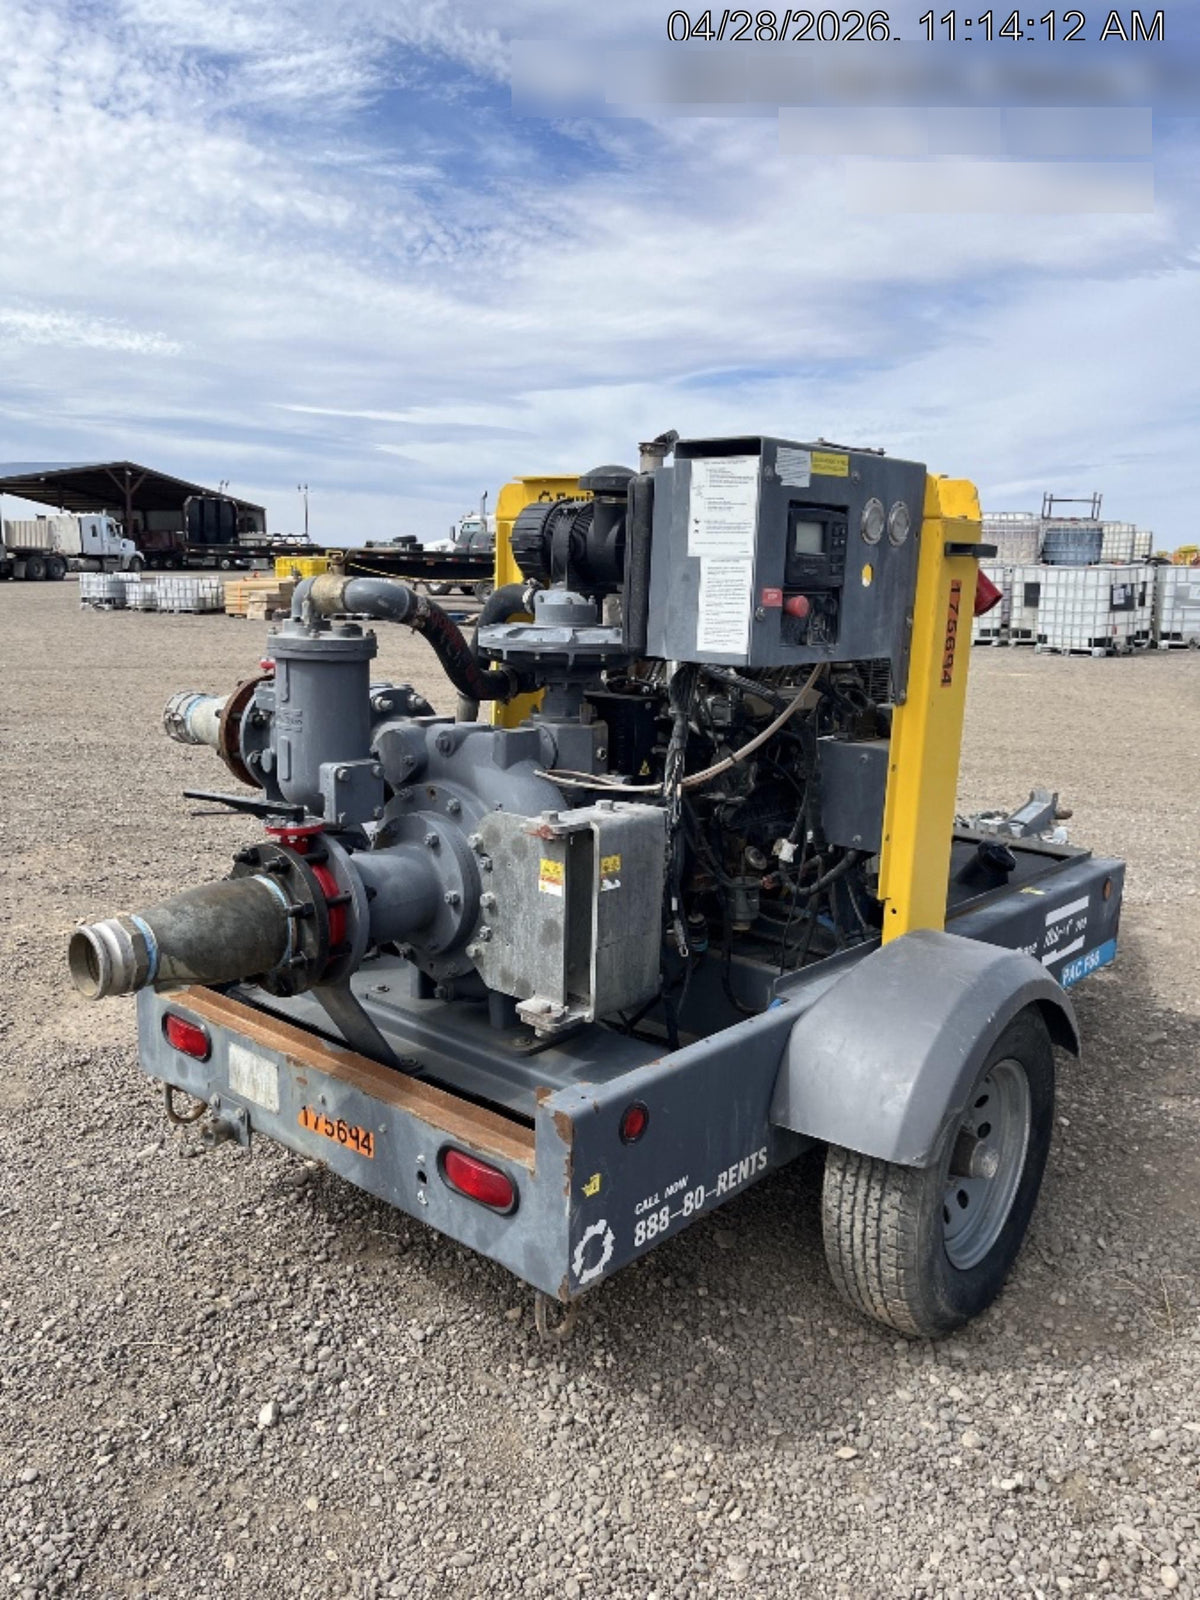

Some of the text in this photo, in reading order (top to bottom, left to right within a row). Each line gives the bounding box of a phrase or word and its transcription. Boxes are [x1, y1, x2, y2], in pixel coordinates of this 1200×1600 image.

[940, 586, 961, 684] 175694
[1062, 962, 1082, 986] PAC
[299, 1105, 374, 1156] 175694
[633, 1146, 768, 1248] 888-80-RENTS
[635, 1175, 689, 1216] CALL NOW
